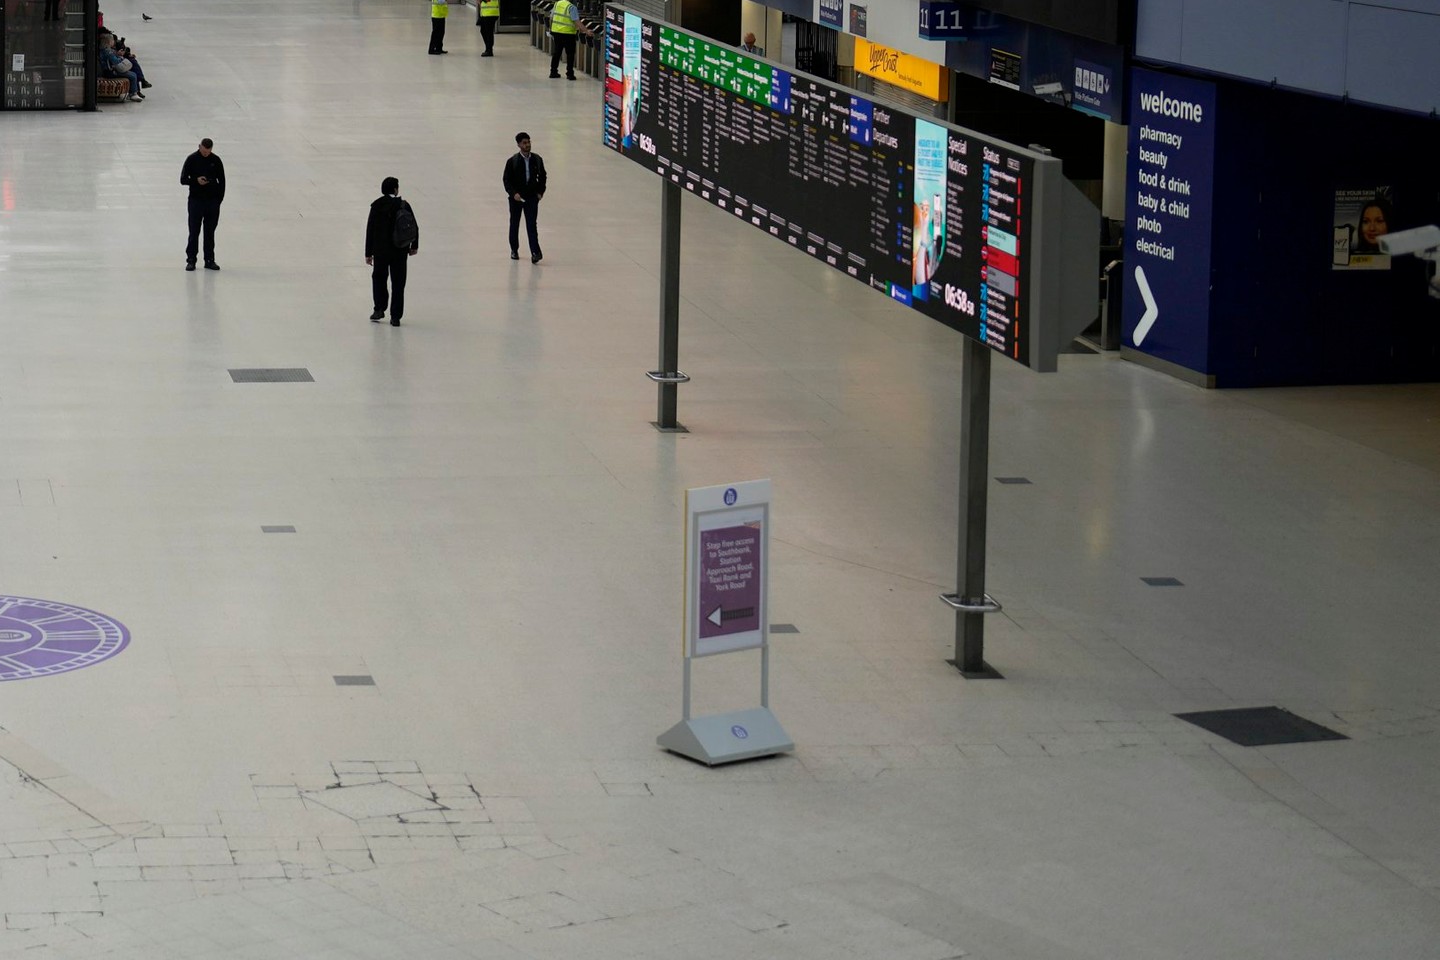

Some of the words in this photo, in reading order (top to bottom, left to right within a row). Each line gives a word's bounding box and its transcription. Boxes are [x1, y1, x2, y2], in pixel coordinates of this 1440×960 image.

[920, 7, 929, 29] 11
[935, 9, 963, 30] 11
[870, 44, 888, 73] Upper
[883, 51, 899, 74] Crust
[1140, 90, 1203, 124] welcome
[948, 136, 967, 155] Special
[1139, 126, 1183, 150] pharmacy
[983, 146, 1000, 164] Status
[1139, 146, 1168, 169] beauty
[948, 156, 968, 176] Notices
[1138, 169, 1159, 188] food
[1159, 176, 1167, 190] &
[1167, 176, 1191, 196] drink
[1137, 190, 1159, 212] baby
[1160, 198, 1167, 212] &
[1167, 199, 1190, 219] child
[1136, 213, 1162, 235] photo
[1136, 237, 1175, 261] electrical
[944, 283, 968, 312] 06:58
[706, 542, 721, 550] Step
[722, 539, 734, 547] free
[735, 537, 755, 546] access
[718, 547, 752, 557] Southbank,
[707, 566, 736, 576] Approach
[720, 557, 742, 565] Station
[710, 575, 722, 583] Taxi
[740, 572, 751, 580] and
[716, 583, 729, 591] York
[730, 581, 746, 589] Road
